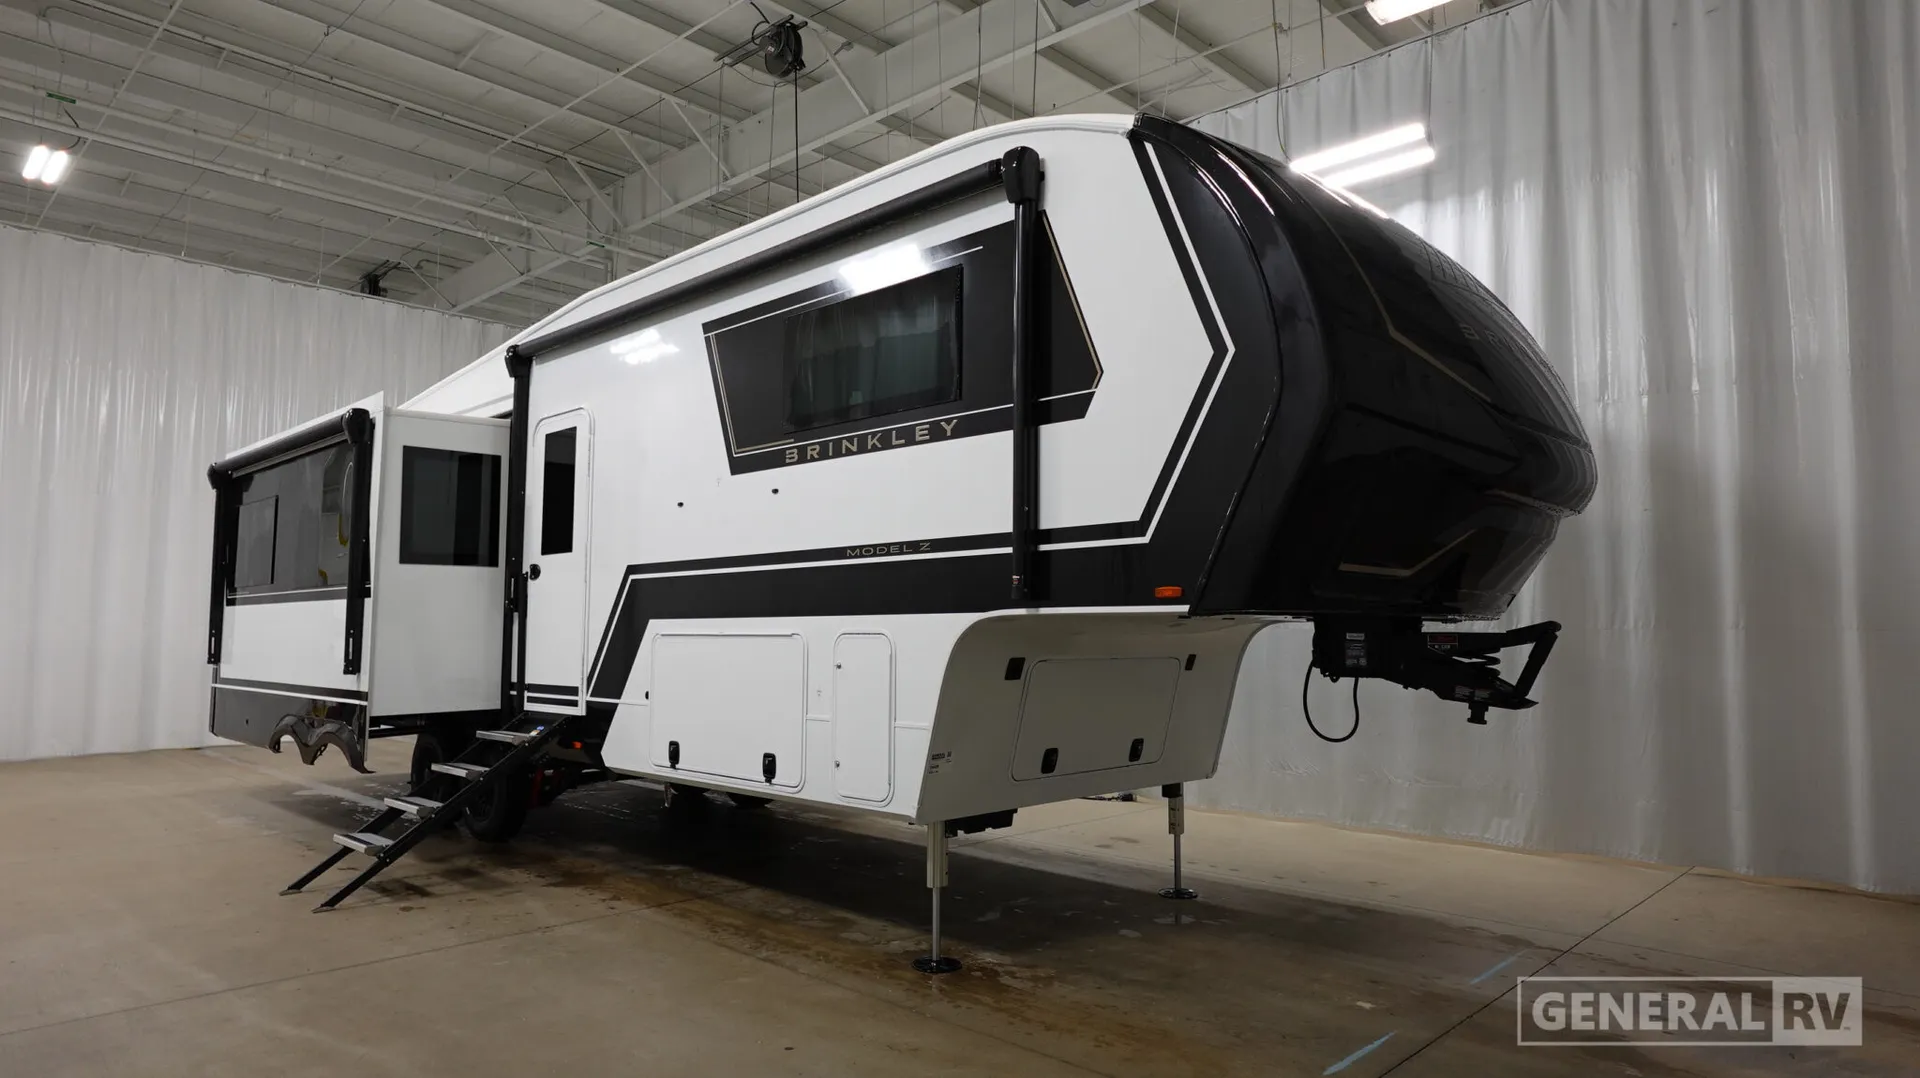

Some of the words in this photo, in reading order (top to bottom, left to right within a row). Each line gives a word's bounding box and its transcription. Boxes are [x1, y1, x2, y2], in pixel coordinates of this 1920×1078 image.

[785, 419, 957, 463] BRINKLEY
[846, 544, 913, 557] MODEL
[919, 542, 931, 551] Z
